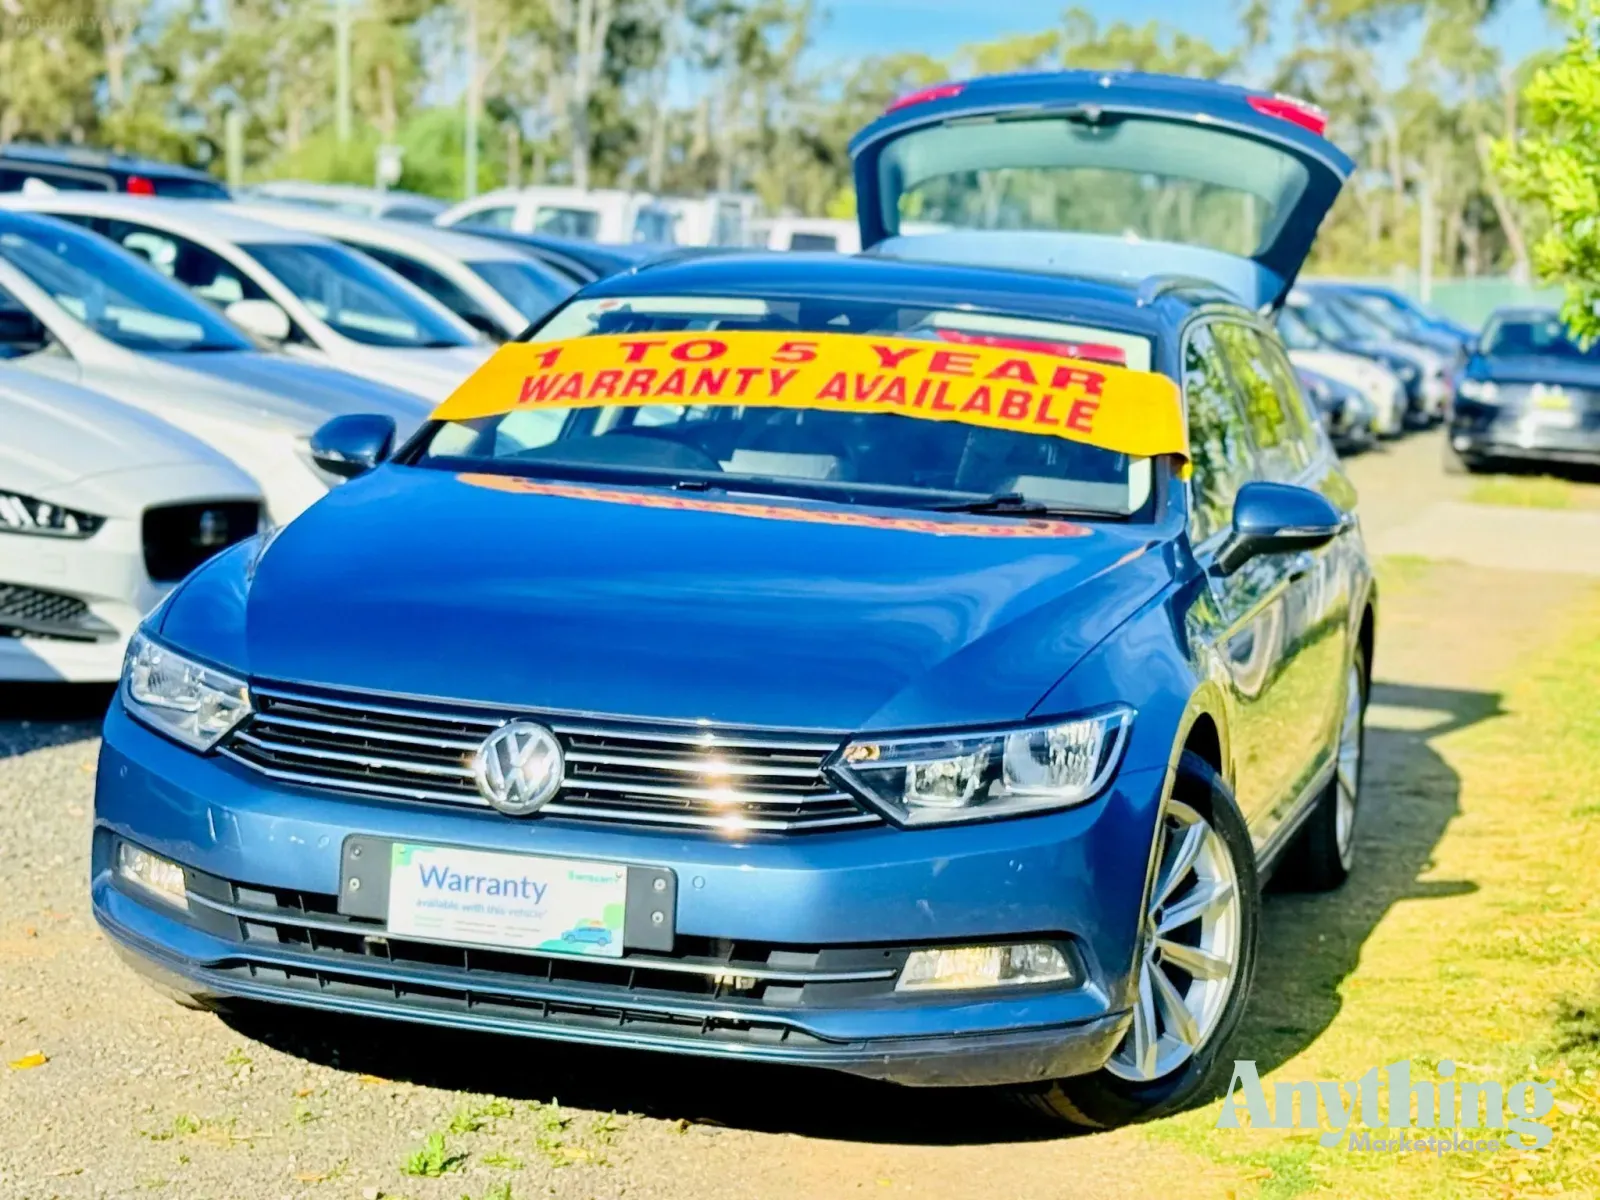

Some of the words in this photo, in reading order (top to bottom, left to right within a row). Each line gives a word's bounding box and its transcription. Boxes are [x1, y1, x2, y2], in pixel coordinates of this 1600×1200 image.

[535, 346, 564, 370] 1
[618, 339, 729, 364] TO
[771, 341, 818, 363] 5
[872, 345, 1107, 397] YEAR
[517, 367, 799, 404] WARRANTY
[816, 371, 1101, 434] AVAILABLE
[415, 898, 459, 911] available
[461, 902, 485, 915] with
[487, 904, 506, 916] this
[418, 862, 548, 905] Warranty
